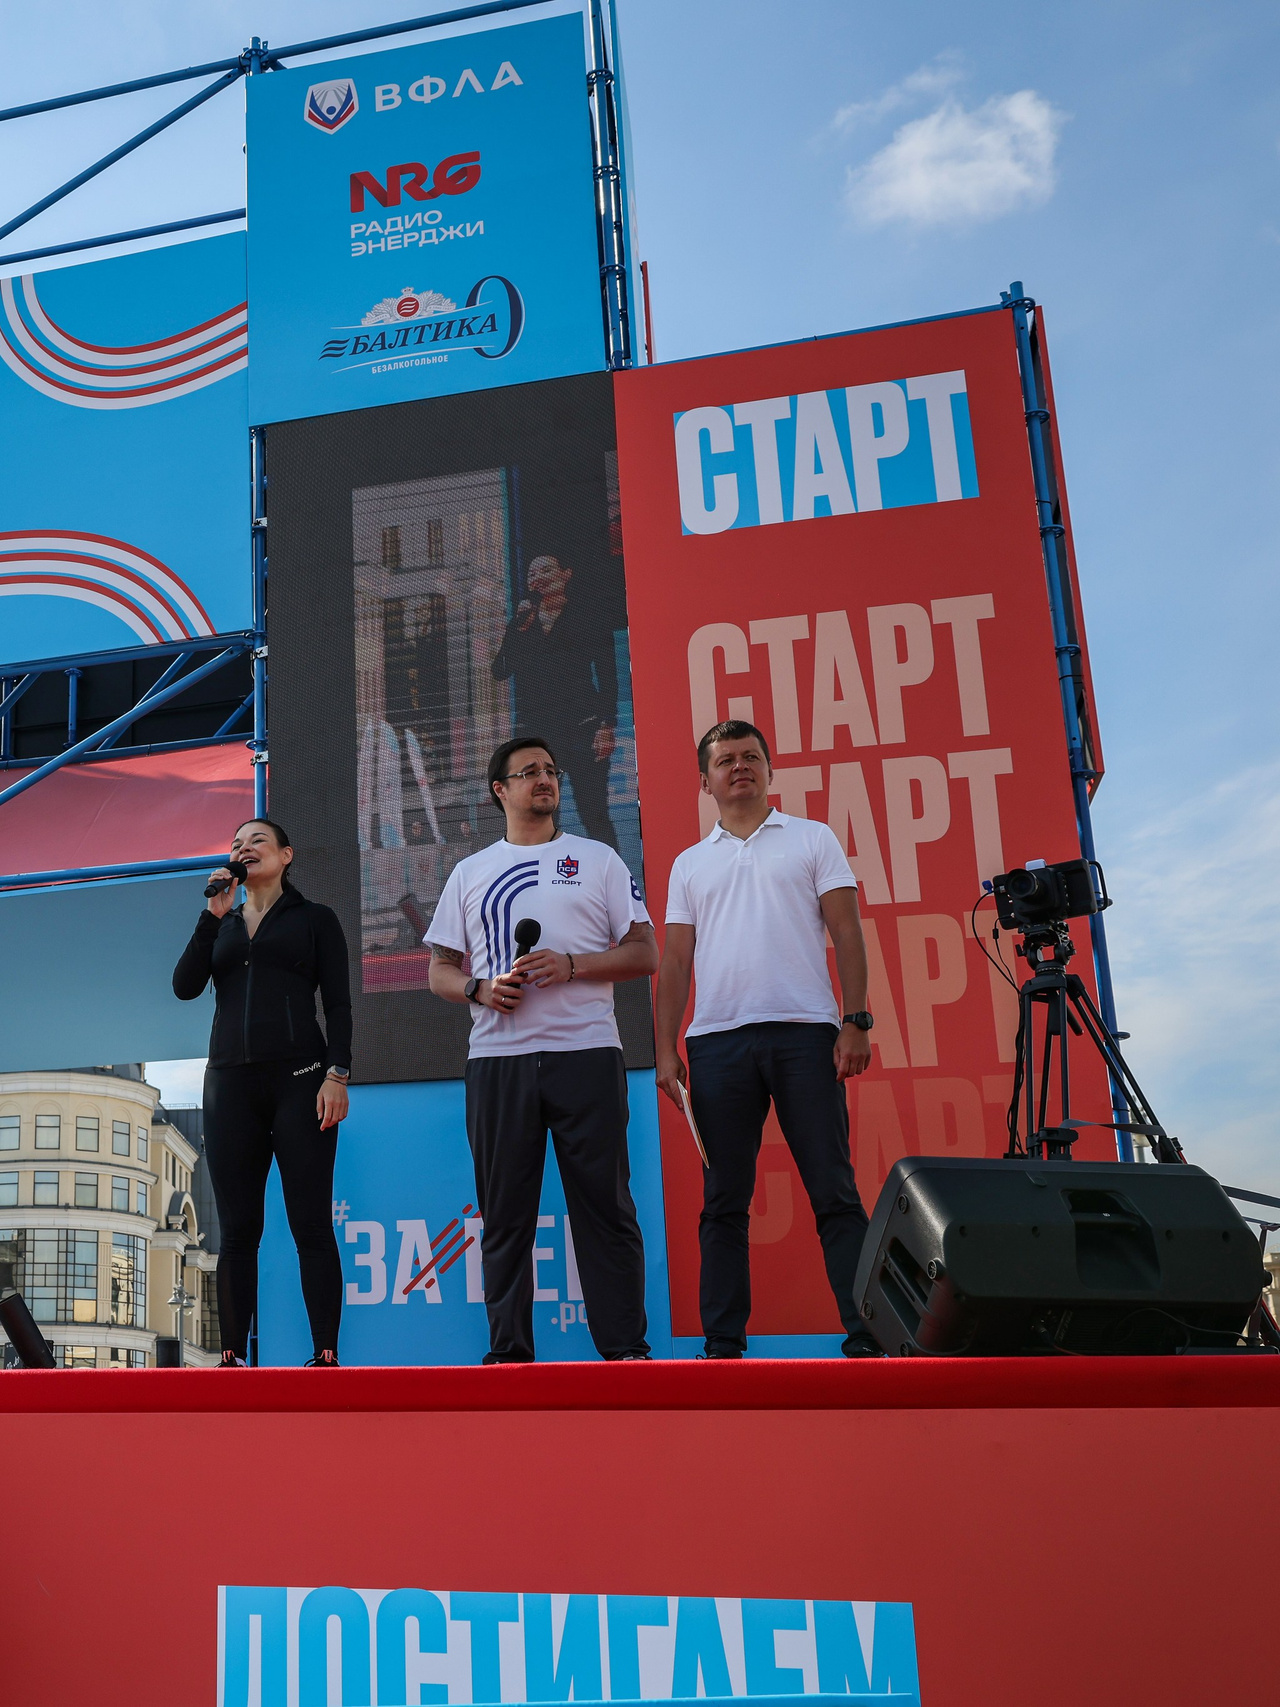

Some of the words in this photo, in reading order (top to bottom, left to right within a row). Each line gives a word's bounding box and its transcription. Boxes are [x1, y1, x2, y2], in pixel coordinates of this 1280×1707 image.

[375, 61, 524, 112] ВФЛА
[350, 151, 481, 213] NRG
[350, 210, 443, 239] РАДИО
[351, 220, 485, 257] ЭНЕРДЖИ
[349, 313, 498, 356] БАЛТИКА
[371, 354, 448, 374] БЕЗАЛКОГОЛЬНОЕ
[674, 369, 967, 535] СТАРТ
[687, 593, 995, 755] СТАРТ
